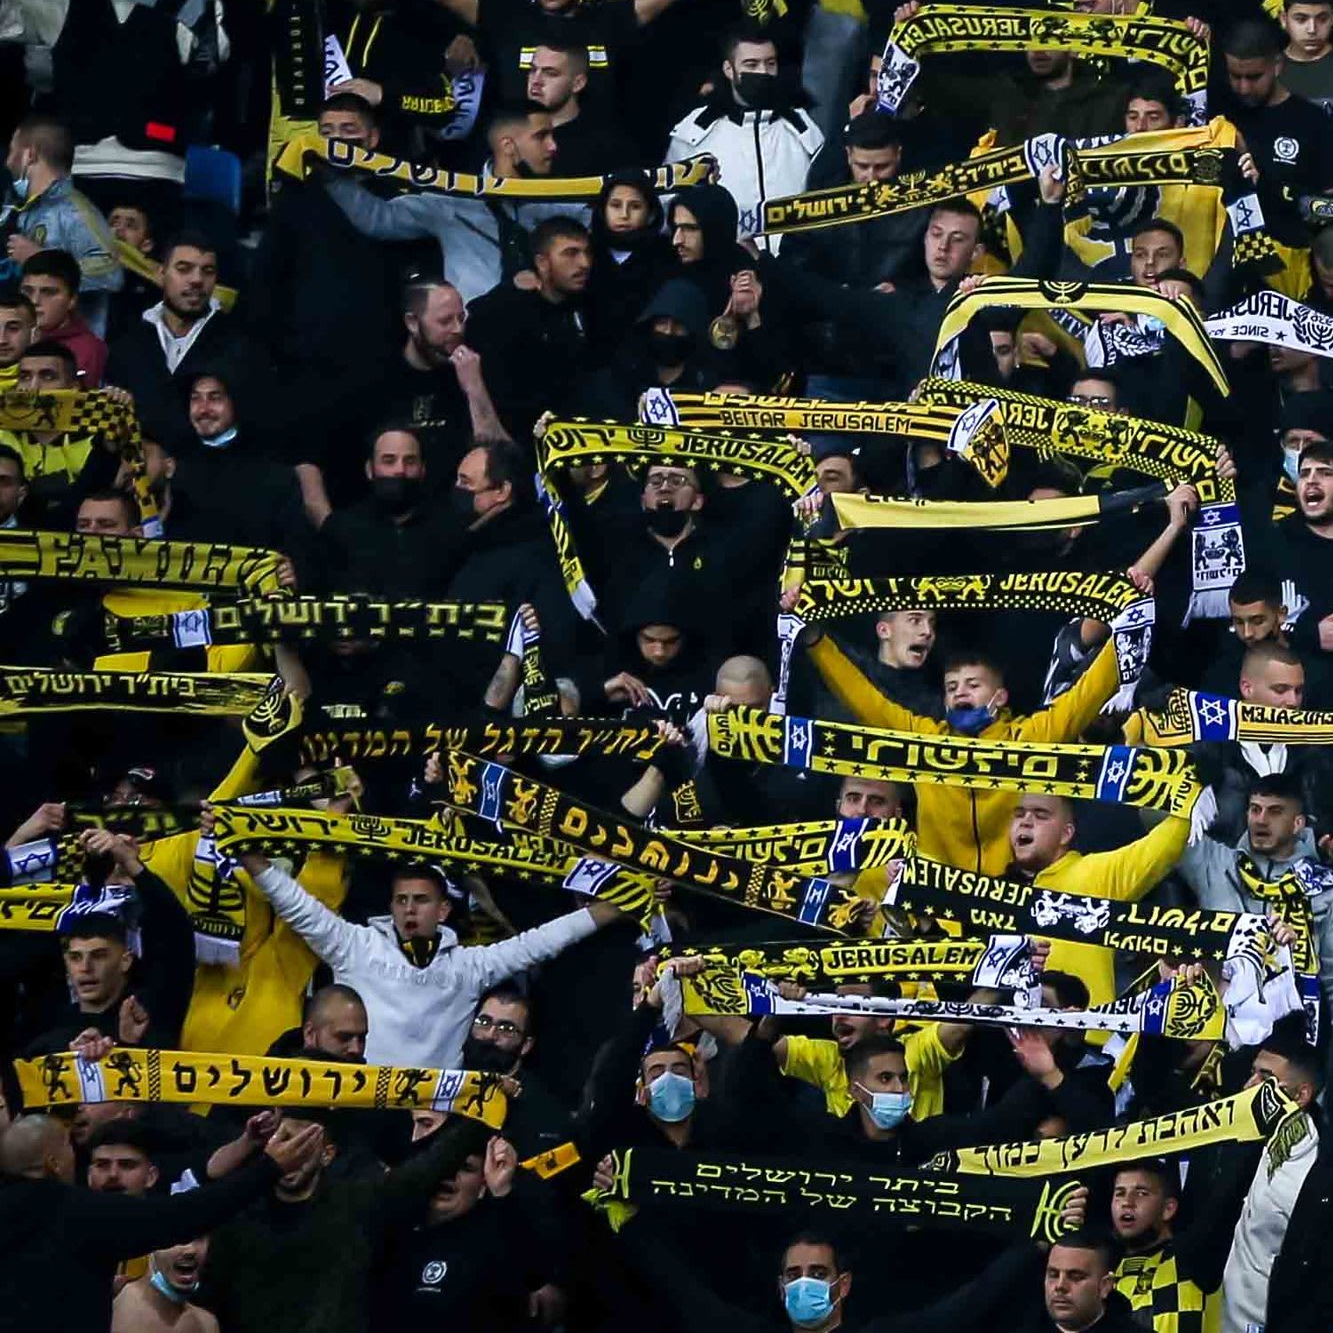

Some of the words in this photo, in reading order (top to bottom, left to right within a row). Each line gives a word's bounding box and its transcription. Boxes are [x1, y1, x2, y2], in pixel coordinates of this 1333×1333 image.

[767, 199, 852, 223] ירושלים
[721, 410, 787, 427] BEITAR
[799, 412, 911, 433] JERUSALEM
[674, 436, 815, 484] JERUSALEM
[1000, 570, 1132, 608] JERUSALEM
[213, 597, 360, 628] ירושלים
[368, 598, 508, 629] בית"ר
[6, 672, 111, 695] ירושלים
[119, 673, 197, 697] בית"ר
[425, 722, 468, 758] של
[902, 860, 1031, 904] JERUSALEM
[1118, 903, 1239, 933] ירושלים
[828, 943, 979, 970] JERUSALEM
[172, 1056, 366, 1100] ירושלים
[1138, 1098, 1236, 1143] ואהבת
[651, 1176, 787, 1205] המדינה
[697, 1162, 853, 1193] ירושלים
[869, 1174, 959, 1194] ביתר
[808, 1189, 858, 1210] של
[871, 1195, 1012, 1222] הקבוצה
